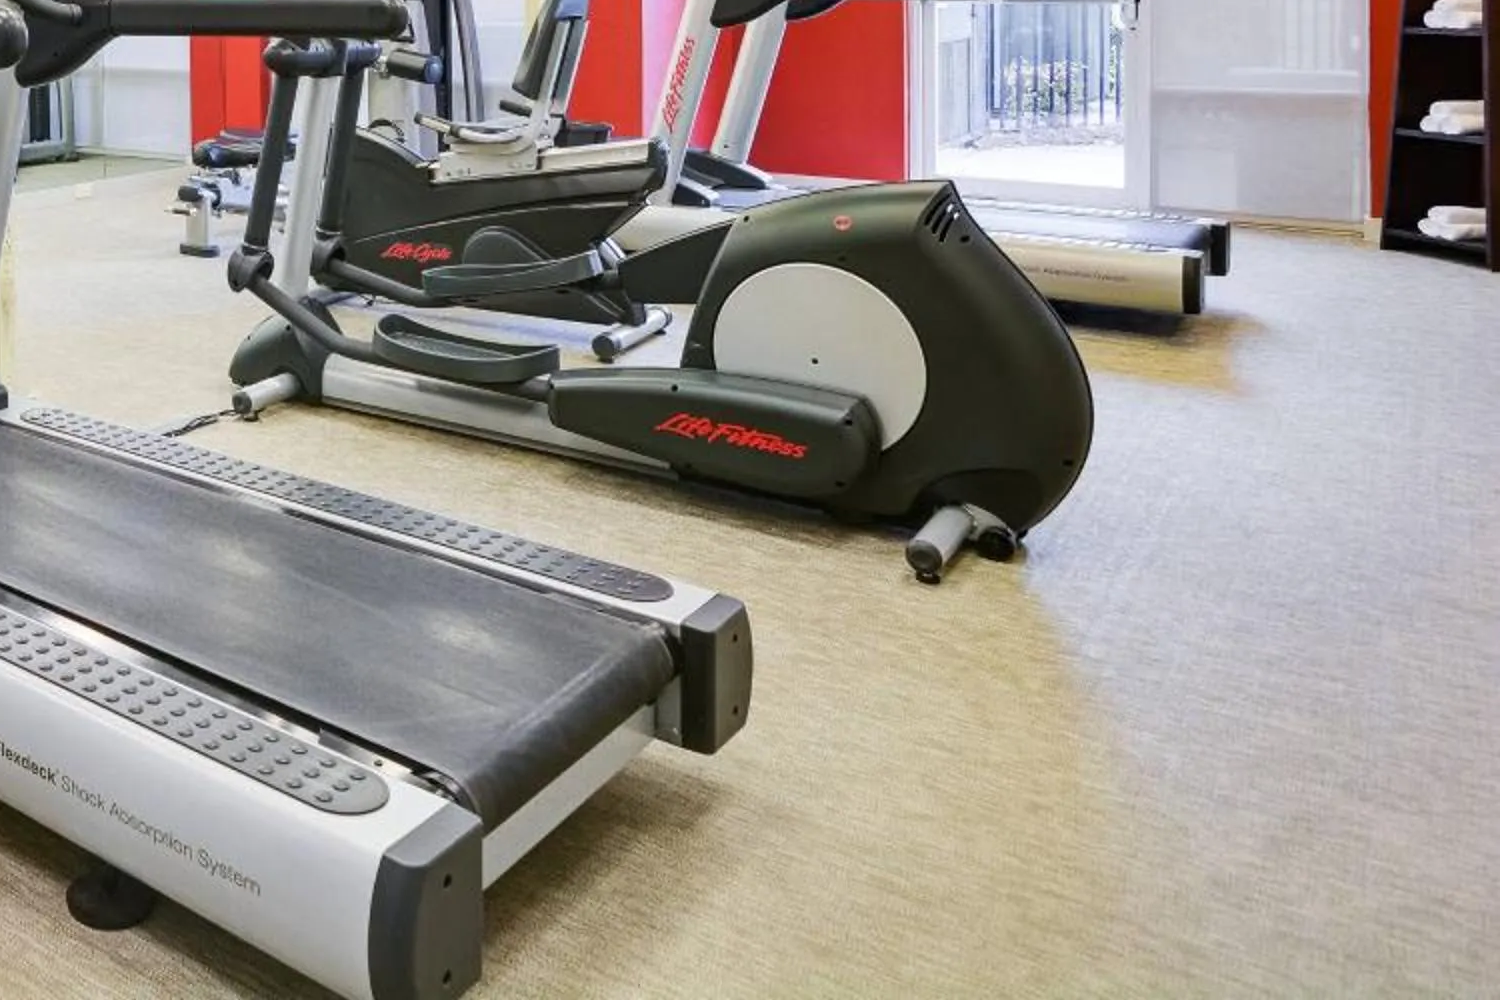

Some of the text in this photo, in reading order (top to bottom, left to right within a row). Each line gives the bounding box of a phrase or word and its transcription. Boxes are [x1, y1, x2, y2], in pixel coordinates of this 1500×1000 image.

[61, 774, 106, 811] Shock
[109, 801, 194, 861] Absorption
[199, 848, 262, 897] System
